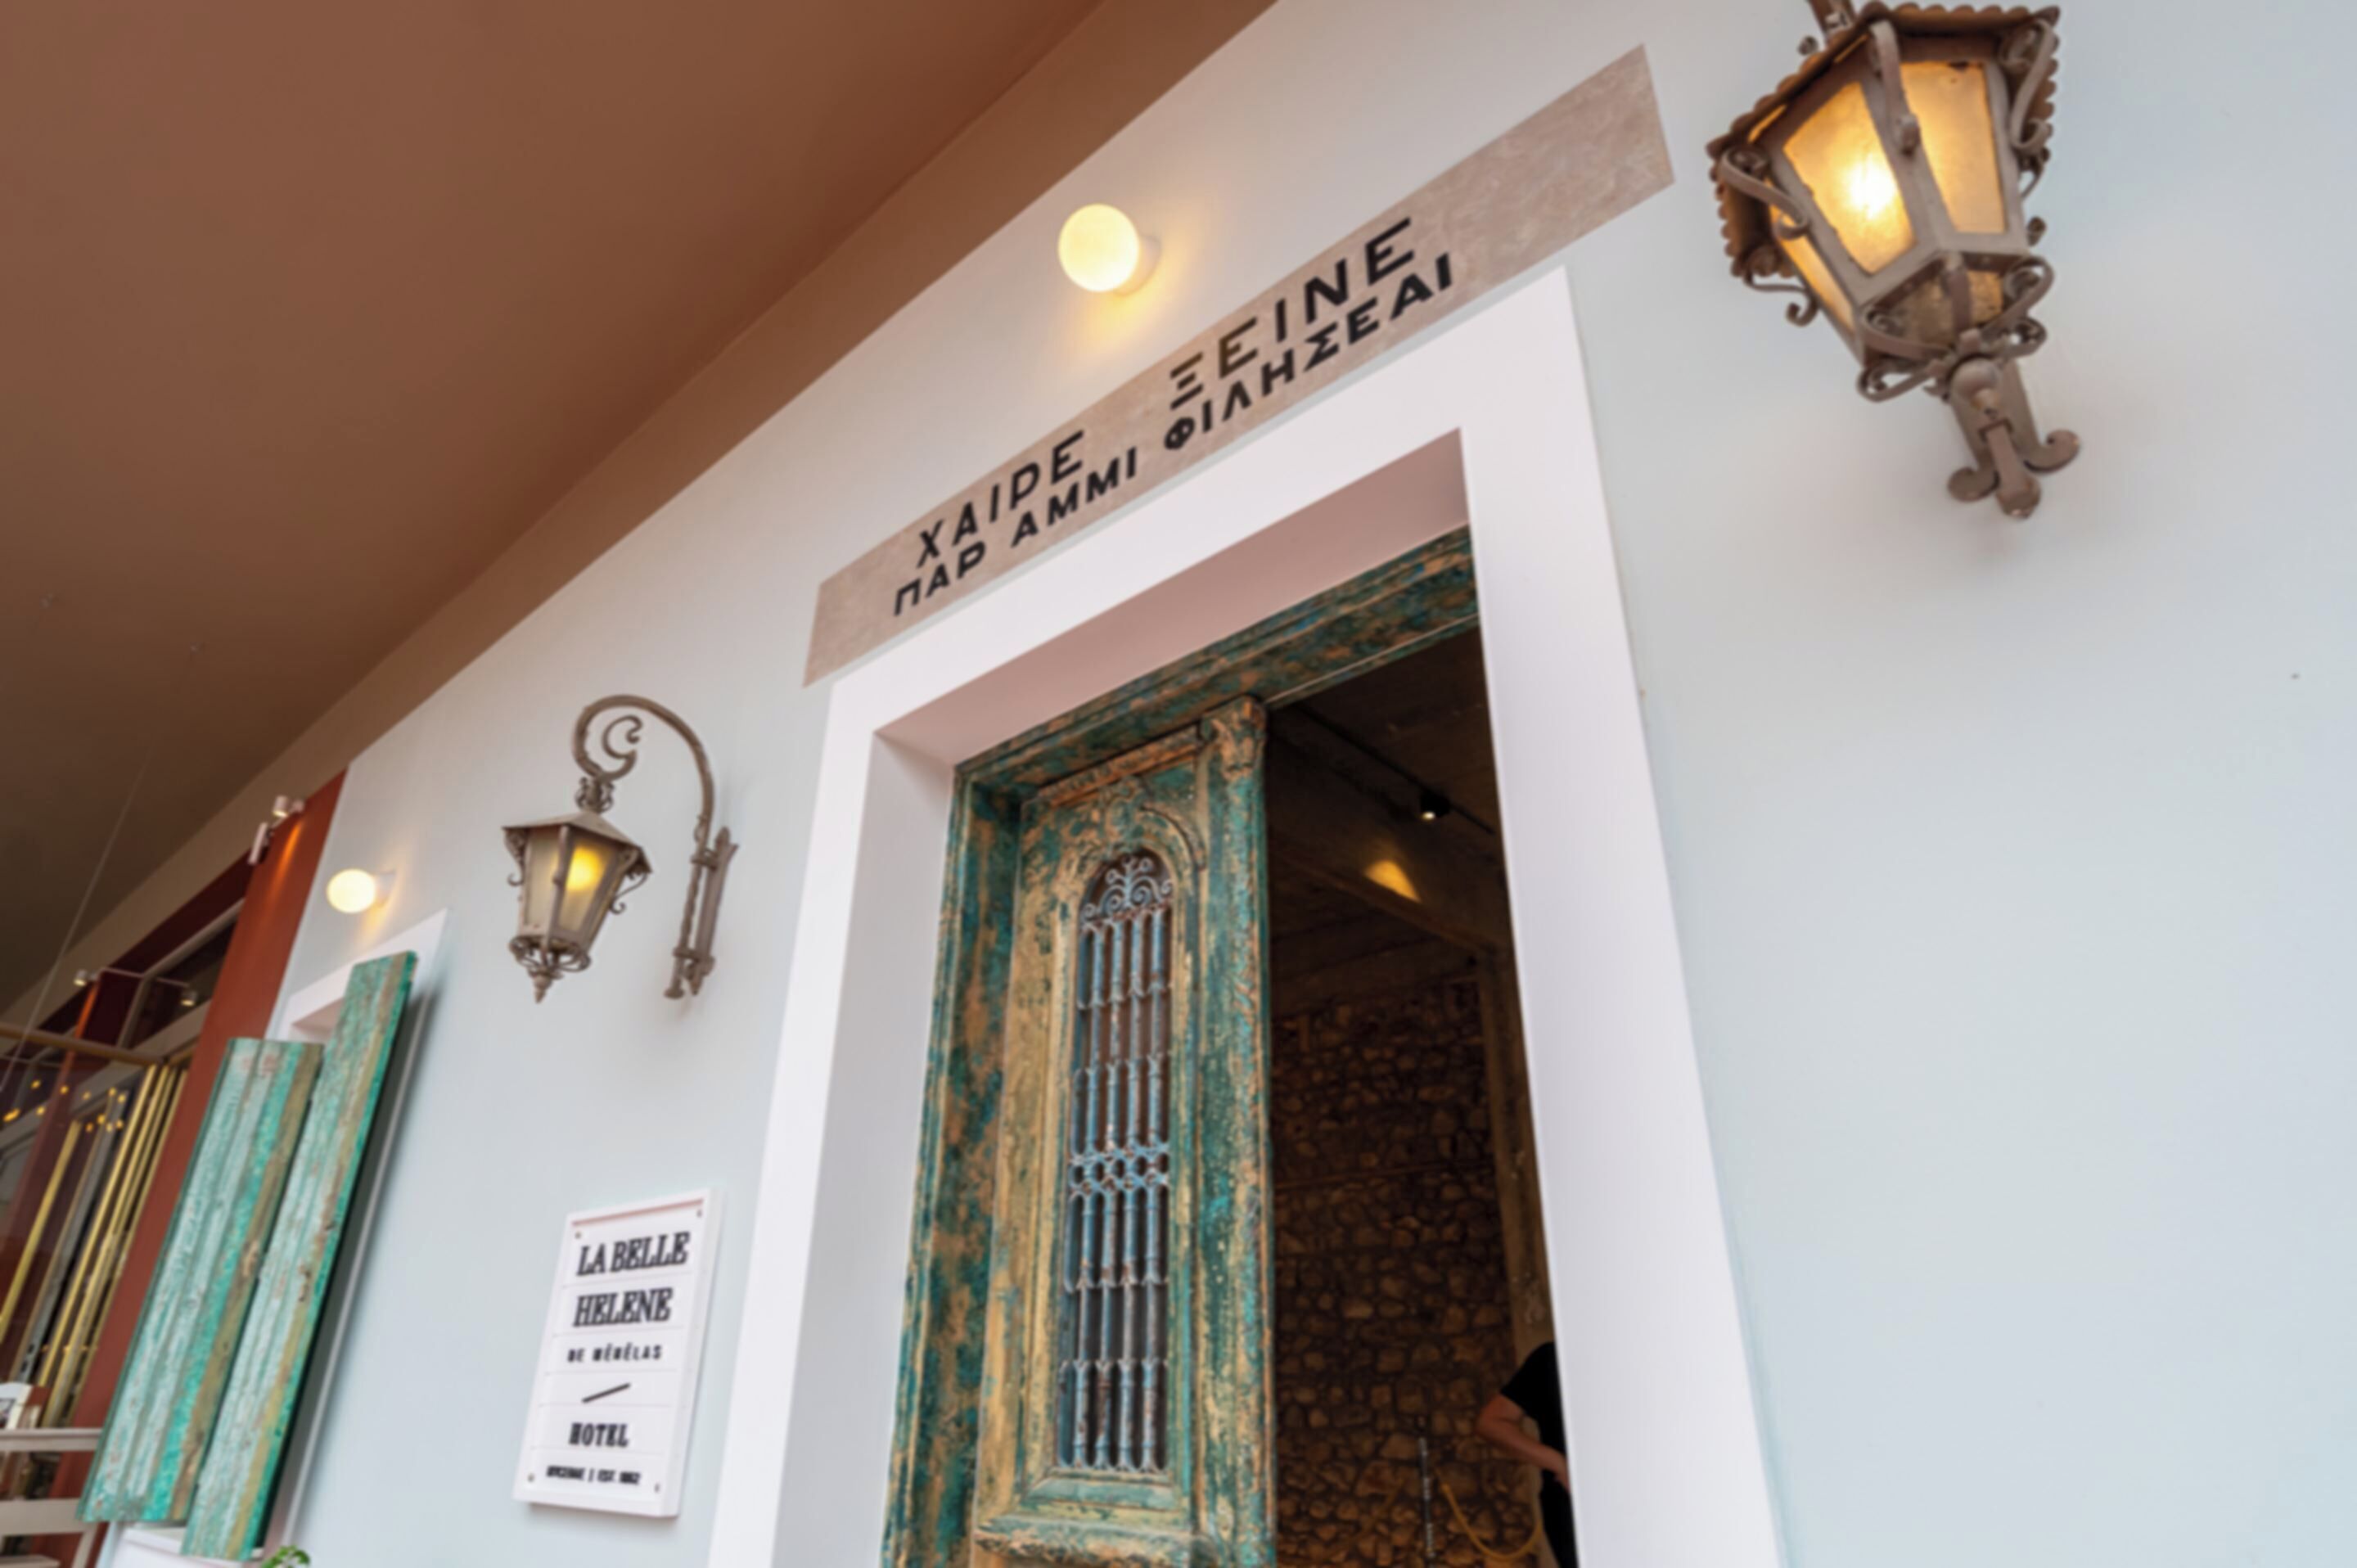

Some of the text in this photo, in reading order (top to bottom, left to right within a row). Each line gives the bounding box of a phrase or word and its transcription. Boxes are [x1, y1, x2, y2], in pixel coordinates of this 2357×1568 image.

[916, 216, 1416, 570] ΧΑΙΡΕ ΞΕΙΝΕ
[893, 252, 1453, 617] ΠΑΡ ΑΜΜΙ ΦΙΛΗΣΕΑΙ
[576, 1231, 691, 1277] LA BELLE
[573, 1286, 674, 1327] HELENE
[568, 1422, 629, 1448] HOTEL
